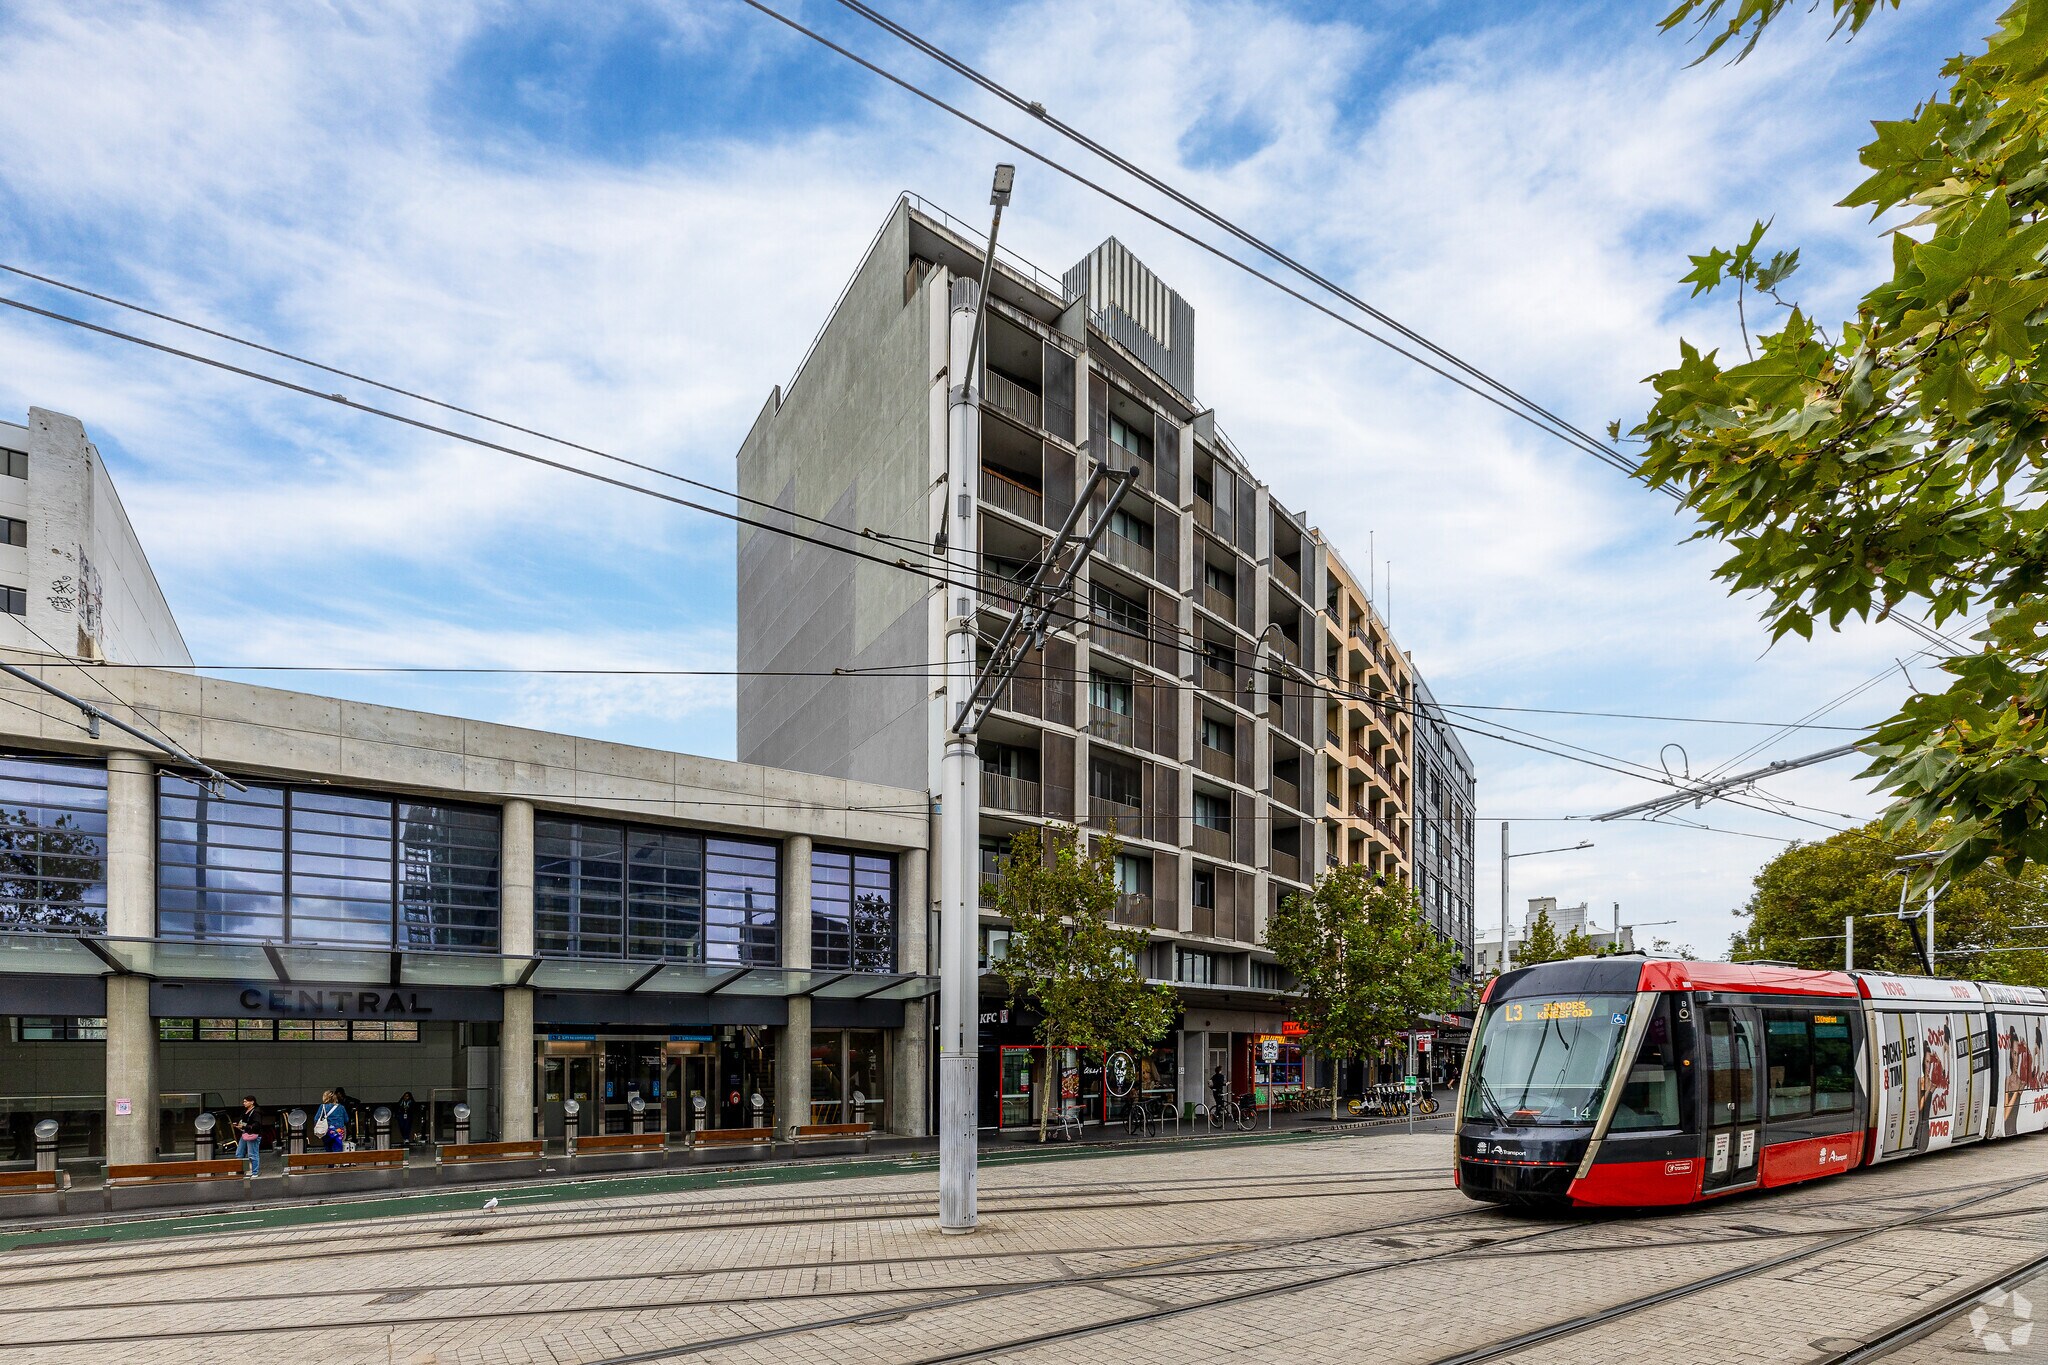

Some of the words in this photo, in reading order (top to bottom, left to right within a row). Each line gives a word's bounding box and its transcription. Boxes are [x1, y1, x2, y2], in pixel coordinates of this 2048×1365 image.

[1881, 981, 1906, 996] nova
[1950, 985, 1970, 999] nova
[239, 989, 432, 1013] CENTRAL
[1543, 1001, 1586, 1012] JUNIORS
[979, 1012, 998, 1024] KFC
[1505, 1004, 1523, 1022] L3
[1537, 1008, 1593, 1020] KINGSFORD
[1881, 1036, 1917, 1067] RICKI-LEE
[1883, 1069, 1890, 1090] &
[1889, 1064, 1903, 1088] TIM
[1571, 1106, 1591, 1118] 14
[1928, 1120, 1950, 1137] nova
[1503, 1149, 1527, 1157] Transport
